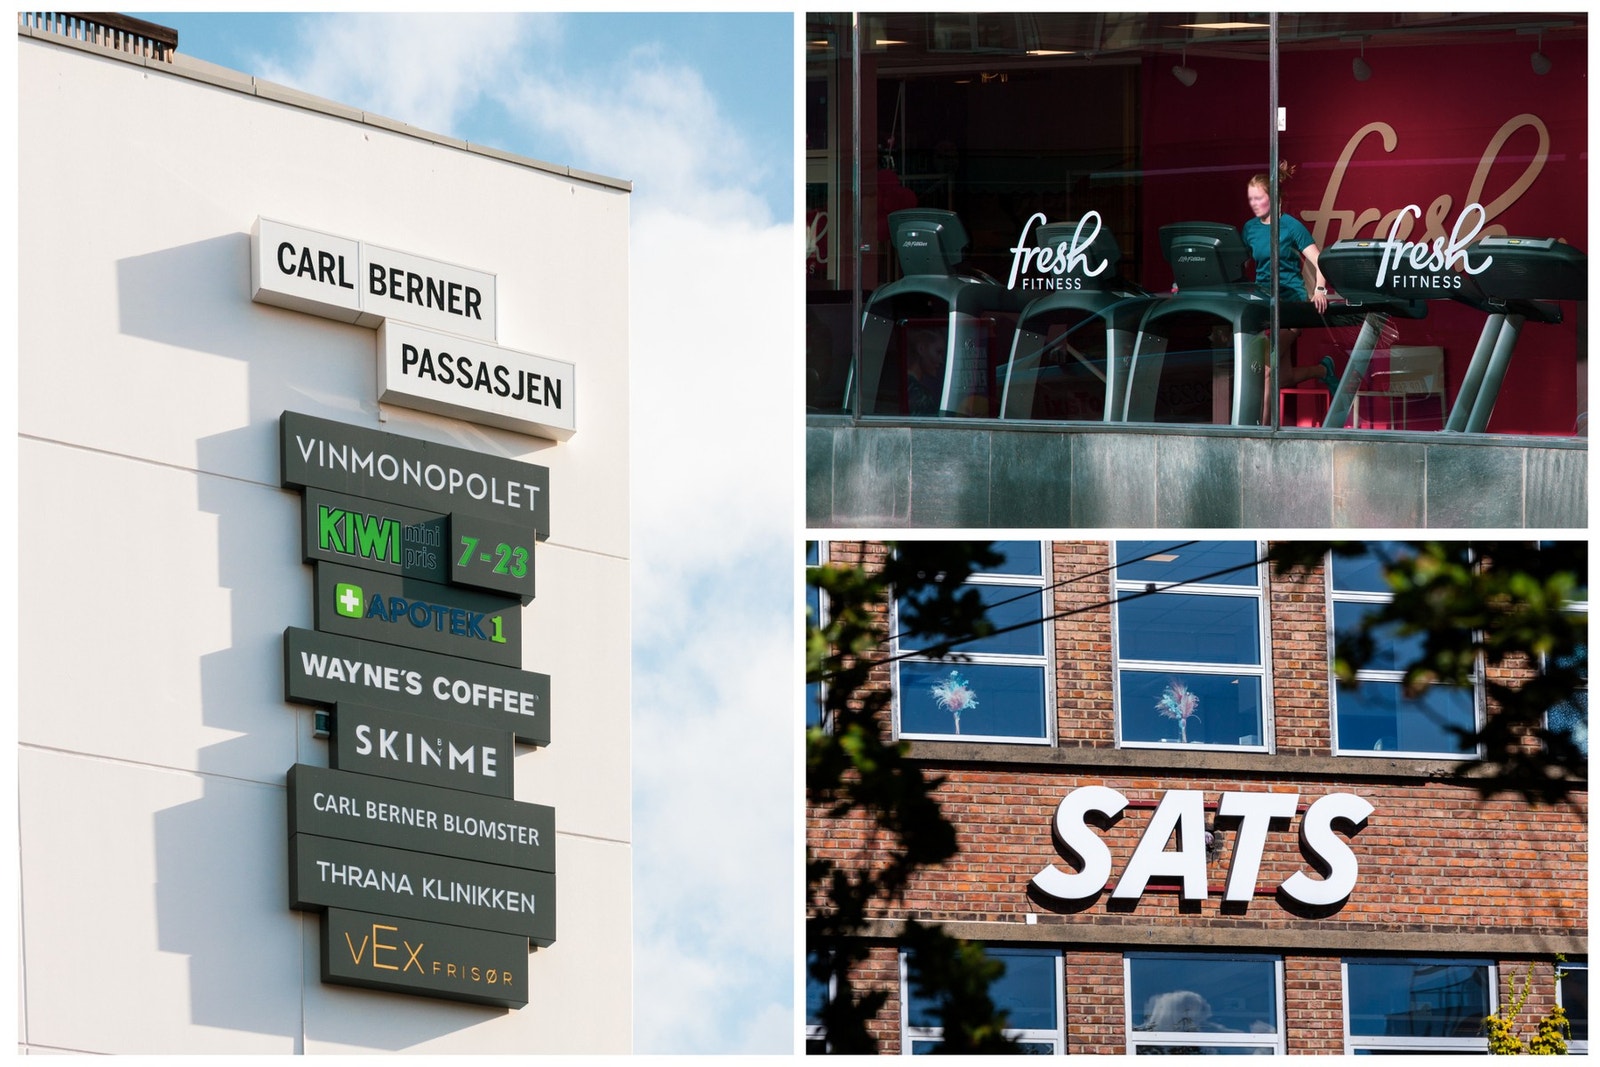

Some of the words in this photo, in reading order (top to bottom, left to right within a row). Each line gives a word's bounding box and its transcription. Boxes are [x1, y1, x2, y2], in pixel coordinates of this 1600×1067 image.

[1007, 210, 1108, 290] fresh
[1375, 203, 1492, 287] fresh
[277, 241, 354, 289] CARL
[369, 262, 482, 320] BERNER
[1022, 277, 1082, 290] FITNESS
[1393, 275, 1462, 288] FITNESS
[402, 343, 562, 409] PASSASJEN
[296, 435, 540, 511] VINMONOPOLET
[317, 503, 402, 565] KIWI
[404, 523, 440, 548] mini
[405, 547, 437, 570] pris
[366, 592, 487, 640] APOTEK
[490, 616, 507, 644] 1
[301, 651, 423, 695] WAYNE'S
[432, 676, 535, 716] COFFEE
[355, 724, 441, 767] SKIN
[448, 741, 497, 777] ME
[313, 792, 361, 817] CARL
[366, 800, 438, 830] BERNER
[444, 813, 540, 847] BLOMSTER
[1030, 785, 1376, 906] SATS
[316, 860, 414, 896] THRANA
[422, 877, 535, 914] KLINIKKEN
[432, 961, 513, 986] FRISØR
